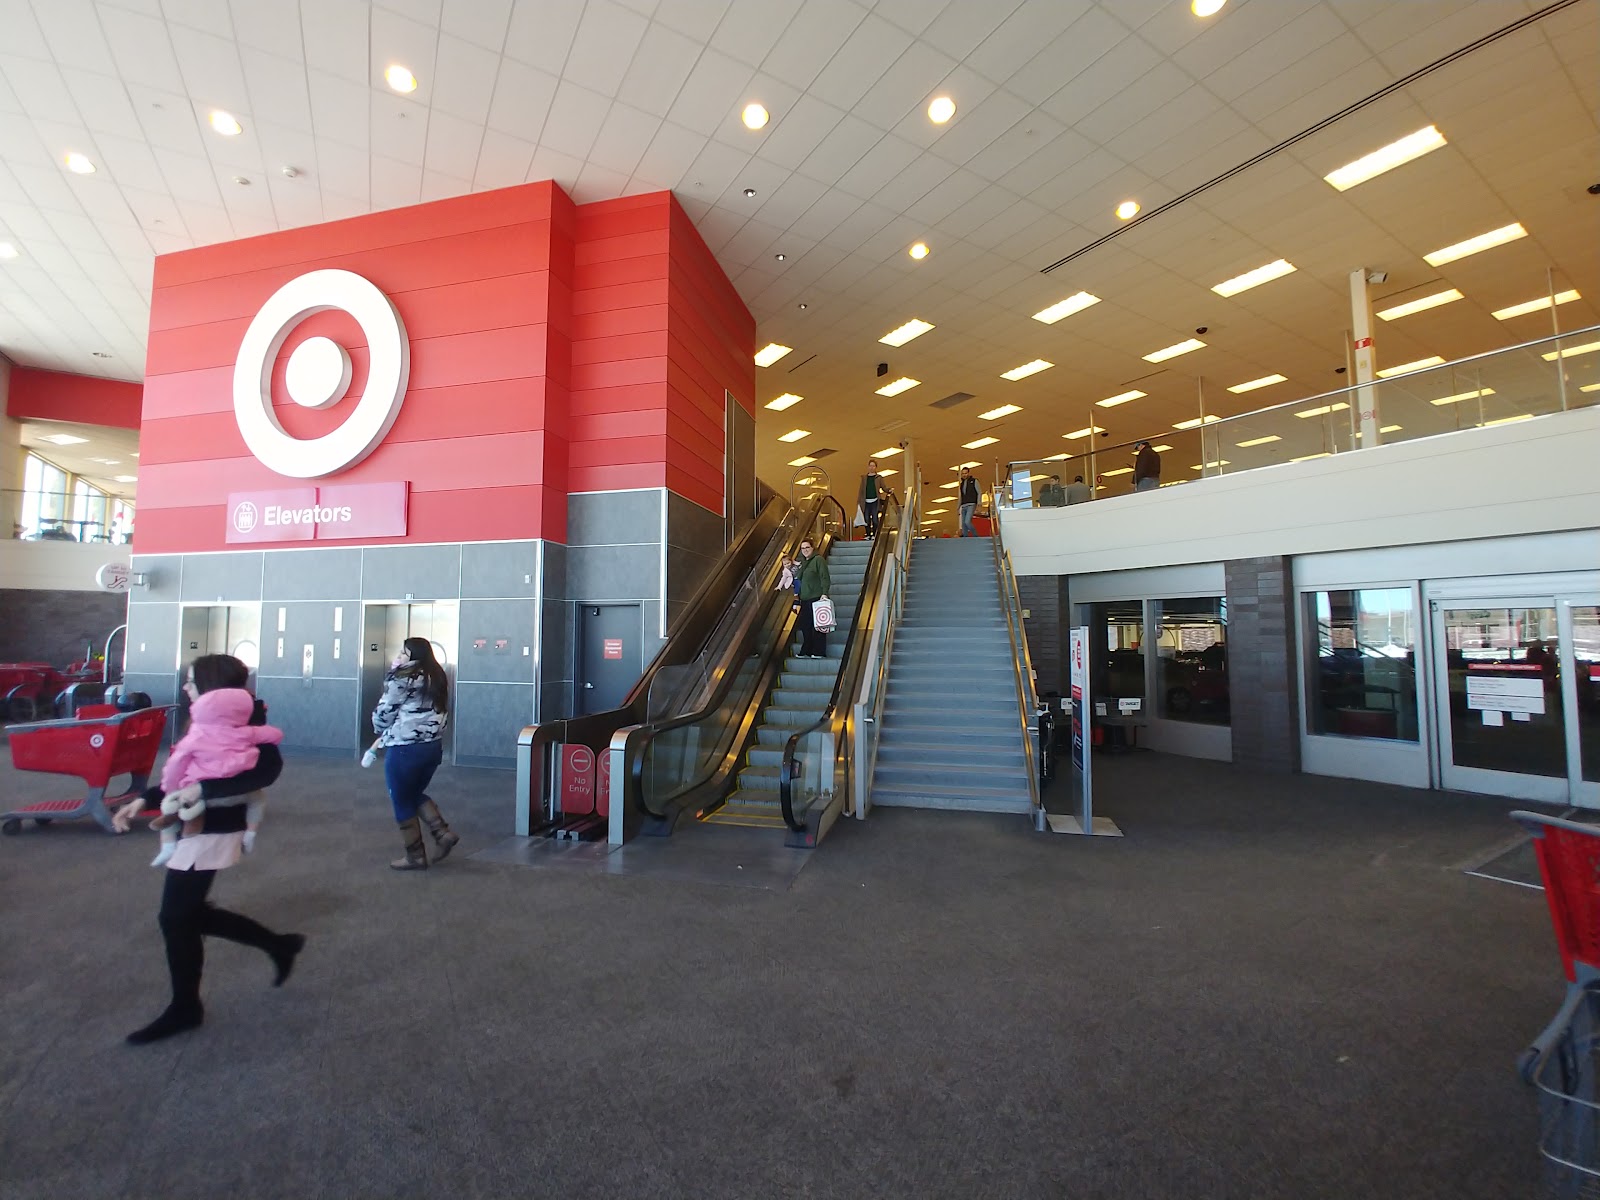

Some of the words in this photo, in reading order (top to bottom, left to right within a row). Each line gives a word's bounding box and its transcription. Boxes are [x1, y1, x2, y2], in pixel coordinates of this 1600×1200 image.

[264, 504, 352, 526] Elevators
[574, 776, 586, 785] No
[569, 784, 591, 795] Entry
